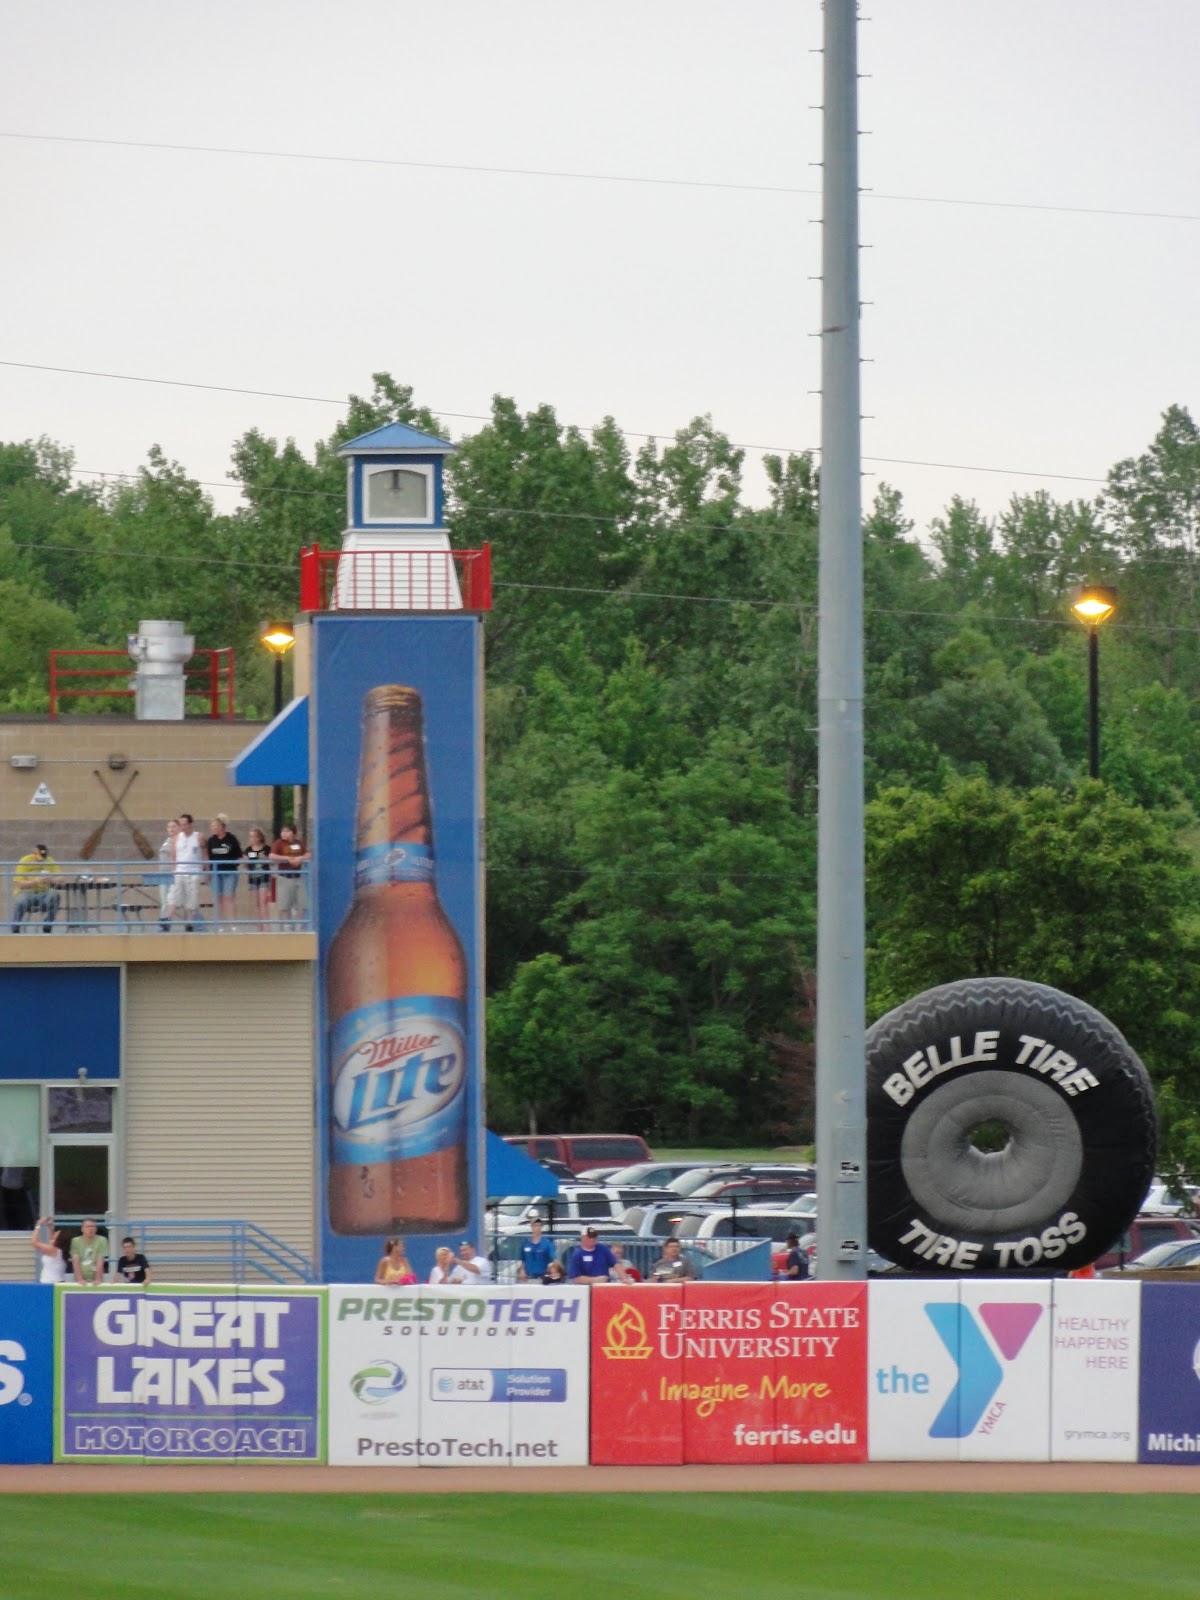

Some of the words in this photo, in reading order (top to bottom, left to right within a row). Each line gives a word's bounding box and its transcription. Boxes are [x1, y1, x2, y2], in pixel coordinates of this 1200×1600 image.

[357, 1035, 441, 1069] Miller
[882, 1030, 1000, 1107] BELLE
[1015, 1034, 1100, 1097] TIRE
[345, 1053, 457, 1132] Lite
[898, 1218, 983, 1270] TIRE
[994, 1211, 1087, 1268] TOSS
[93, 1298, 290, 1348] GREAT
[337, 1297, 581, 1323] PRESTOTECH
[657, 1303, 762, 1330] FERRIS
[769, 1301, 860, 1329] STATE
[382, 1325, 537, 1337] SOLUTIONS
[1057, 1317, 1130, 1331] HEALTHY
[657, 1332, 840, 1359] UNIVERSITY
[1054, 1337, 1130, 1351] HAPPENS
[1085, 1356, 1129, 1370] HERE
[96, 1356, 286, 1406] LAKES
[457, 1377, 486, 1391] at&t
[505, 1386, 553, 1397] Provider
[506, 1373, 552, 1384] Solution
[876, 1365, 930, 1394] the
[659, 1376, 750, 1417] Imagine
[758, 1375, 832, 1400] More
[977, 1400, 1008, 1437] YMCA
[75, 1425, 307, 1453] MOTORCOACH
[356, 1437, 559, 1458] PrestoTech.net
[732, 1423, 858, 1446] ferris.edu
[1063, 1430, 1132, 1442] grymca.org
